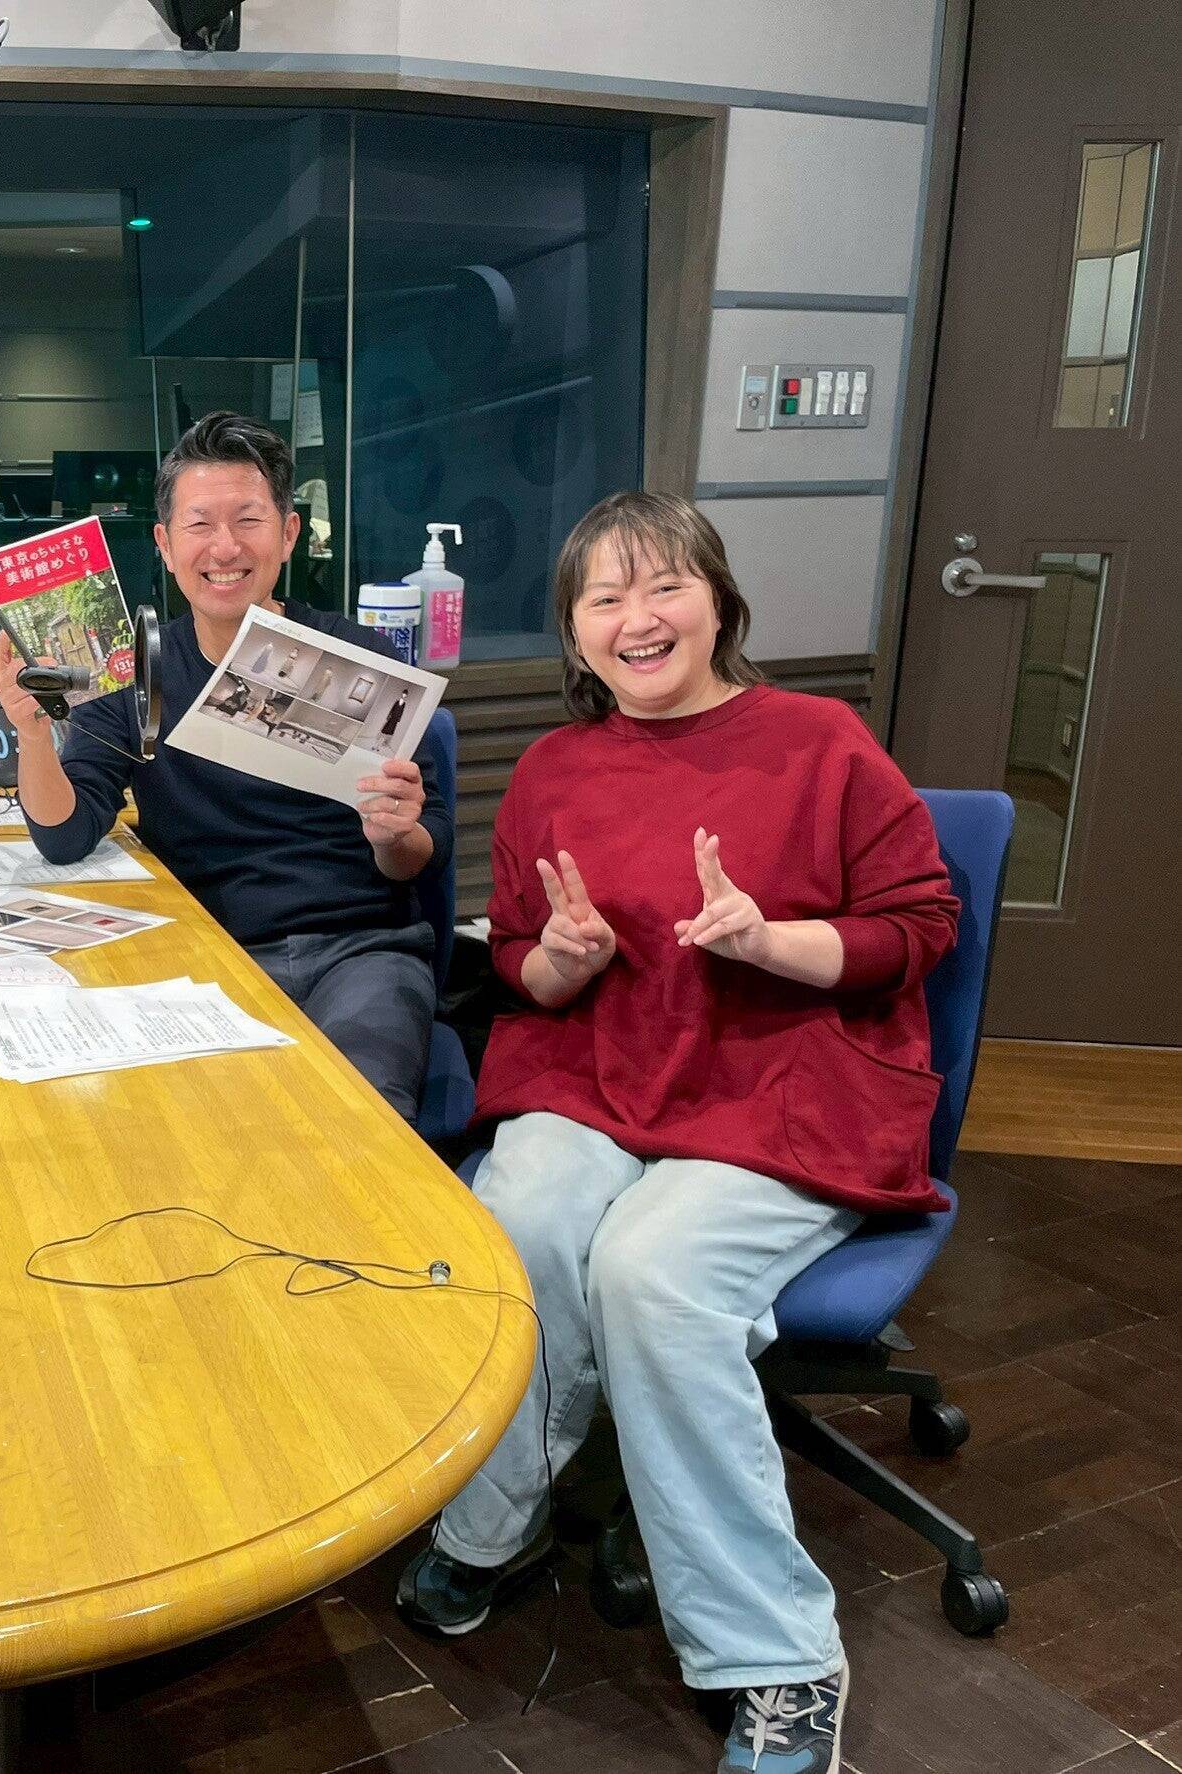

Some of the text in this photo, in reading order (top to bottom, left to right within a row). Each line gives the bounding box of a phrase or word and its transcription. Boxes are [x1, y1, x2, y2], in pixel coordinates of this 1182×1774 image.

[0, 533, 86, 570] 東京のちいさな
[5, 547, 90, 587] 美術館めぐり
